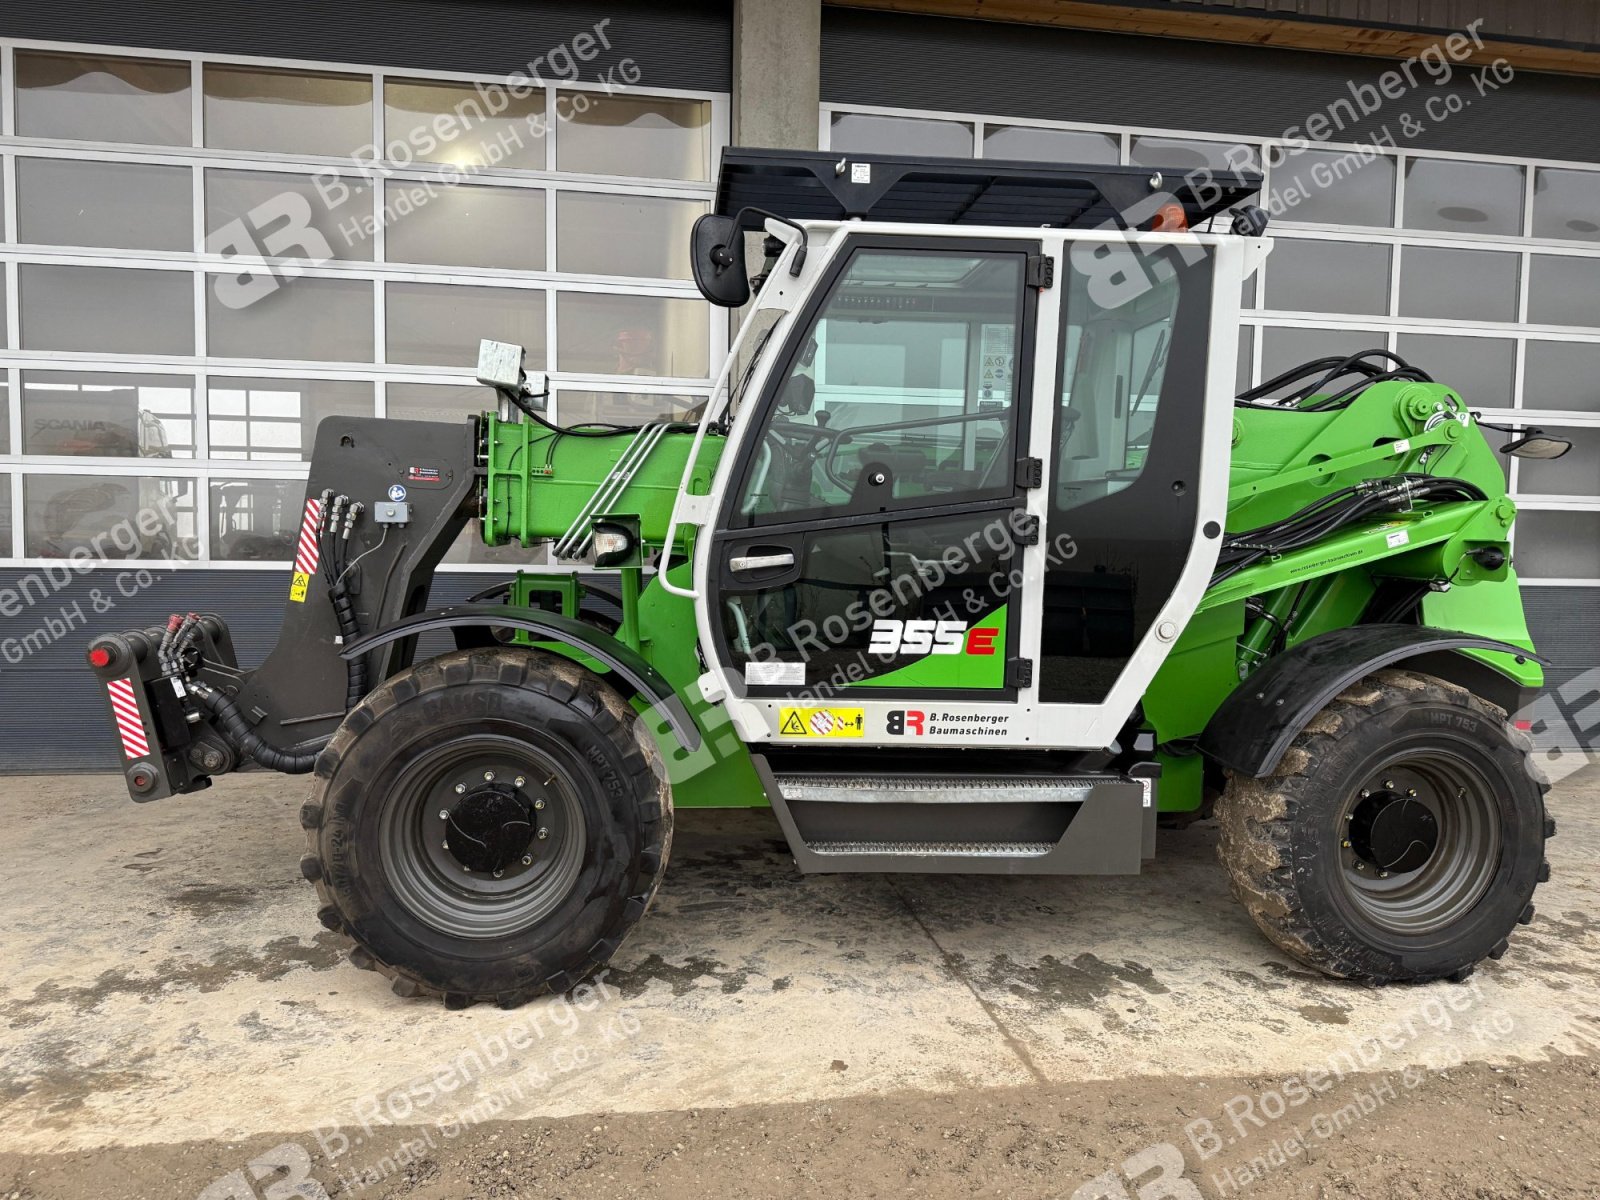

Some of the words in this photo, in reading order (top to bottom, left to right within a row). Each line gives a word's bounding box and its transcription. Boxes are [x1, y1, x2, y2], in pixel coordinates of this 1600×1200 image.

[33, 419, 106, 436] SCANIA
[868, 619, 999, 655] 355E
[942, 713, 1009, 723] Rosenberger
[1429, 710, 1452, 726] MPT
[1456, 716, 1479, 733] 753
[929, 726, 1008, 736] Baumaschinen
[586, 744, 610, 771] MPT
[602, 769, 625, 799] 753
